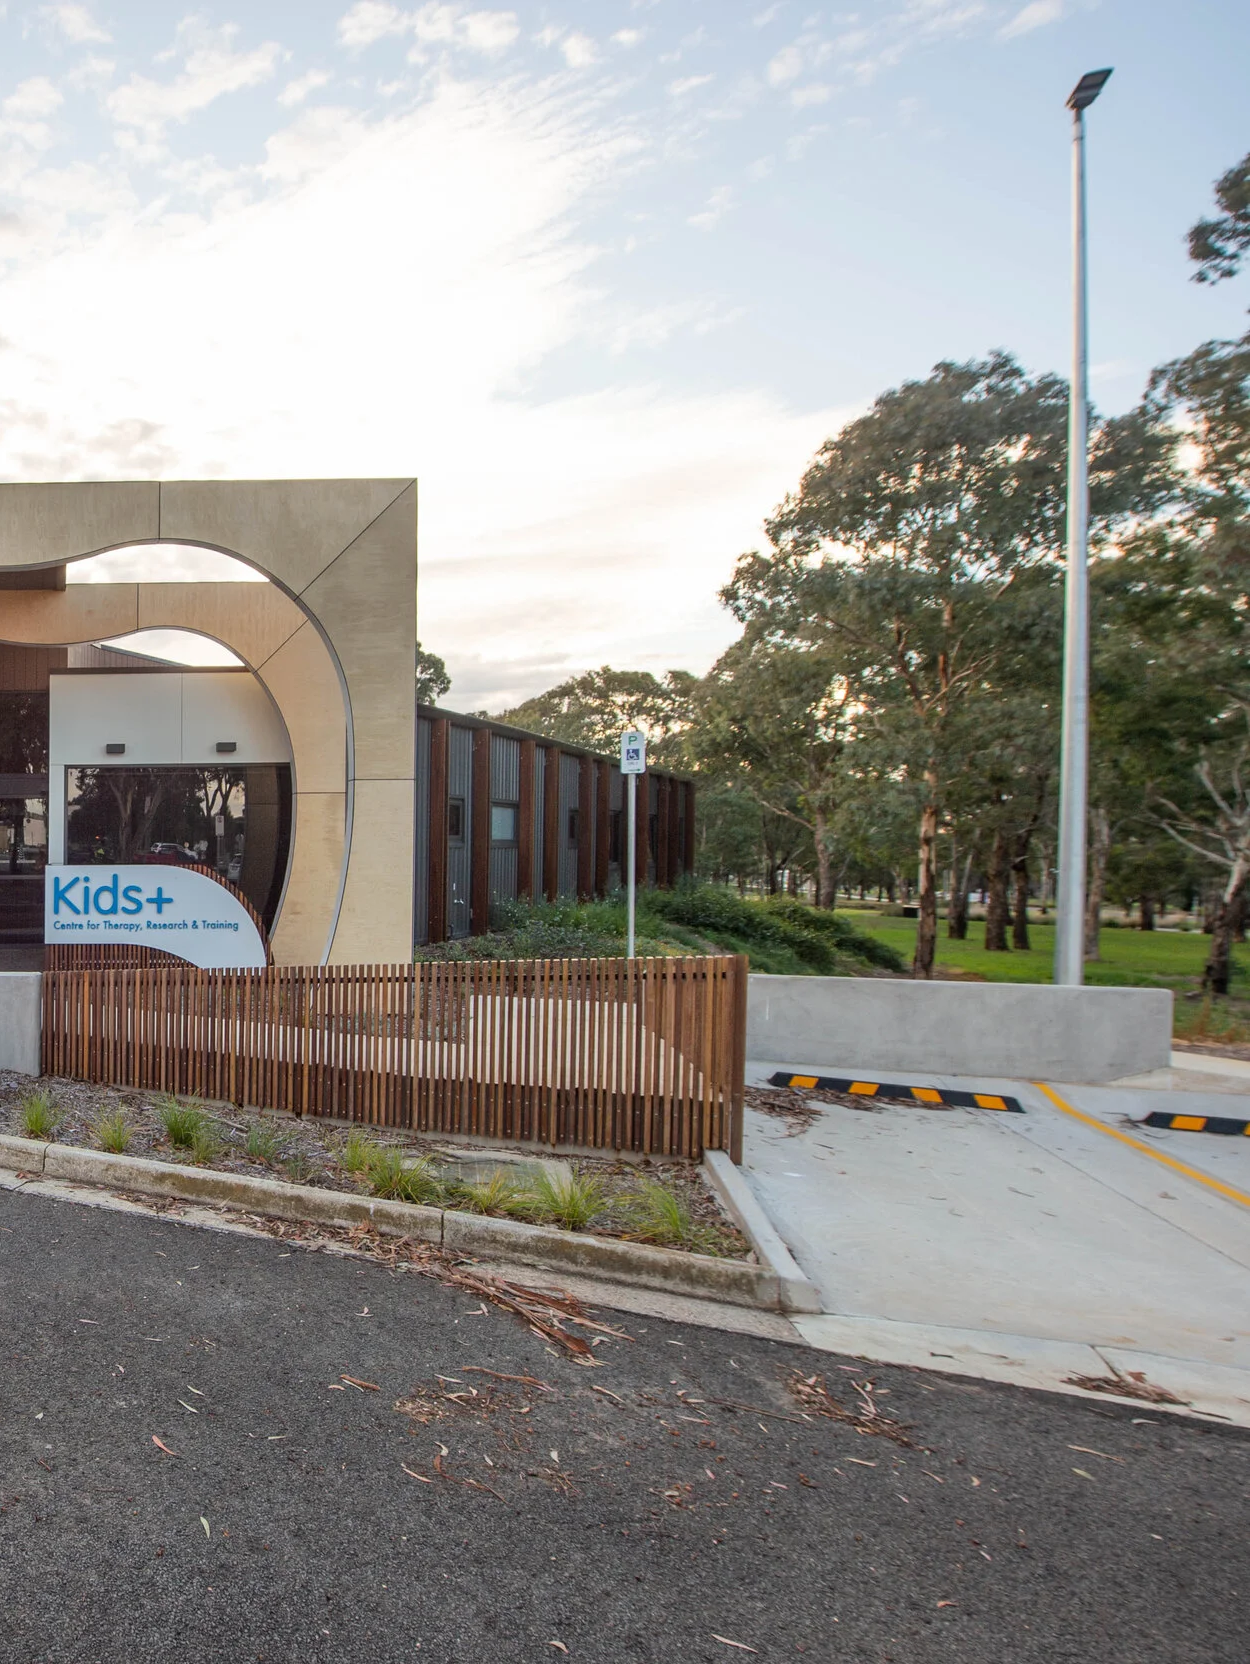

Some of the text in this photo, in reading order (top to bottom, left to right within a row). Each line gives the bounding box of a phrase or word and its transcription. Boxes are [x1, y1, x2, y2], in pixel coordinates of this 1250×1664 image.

[628, 735, 638, 745] P
[53, 873, 174, 915] Kids+
[53, 920, 239, 932] Centre for Therapy, Research & Training
